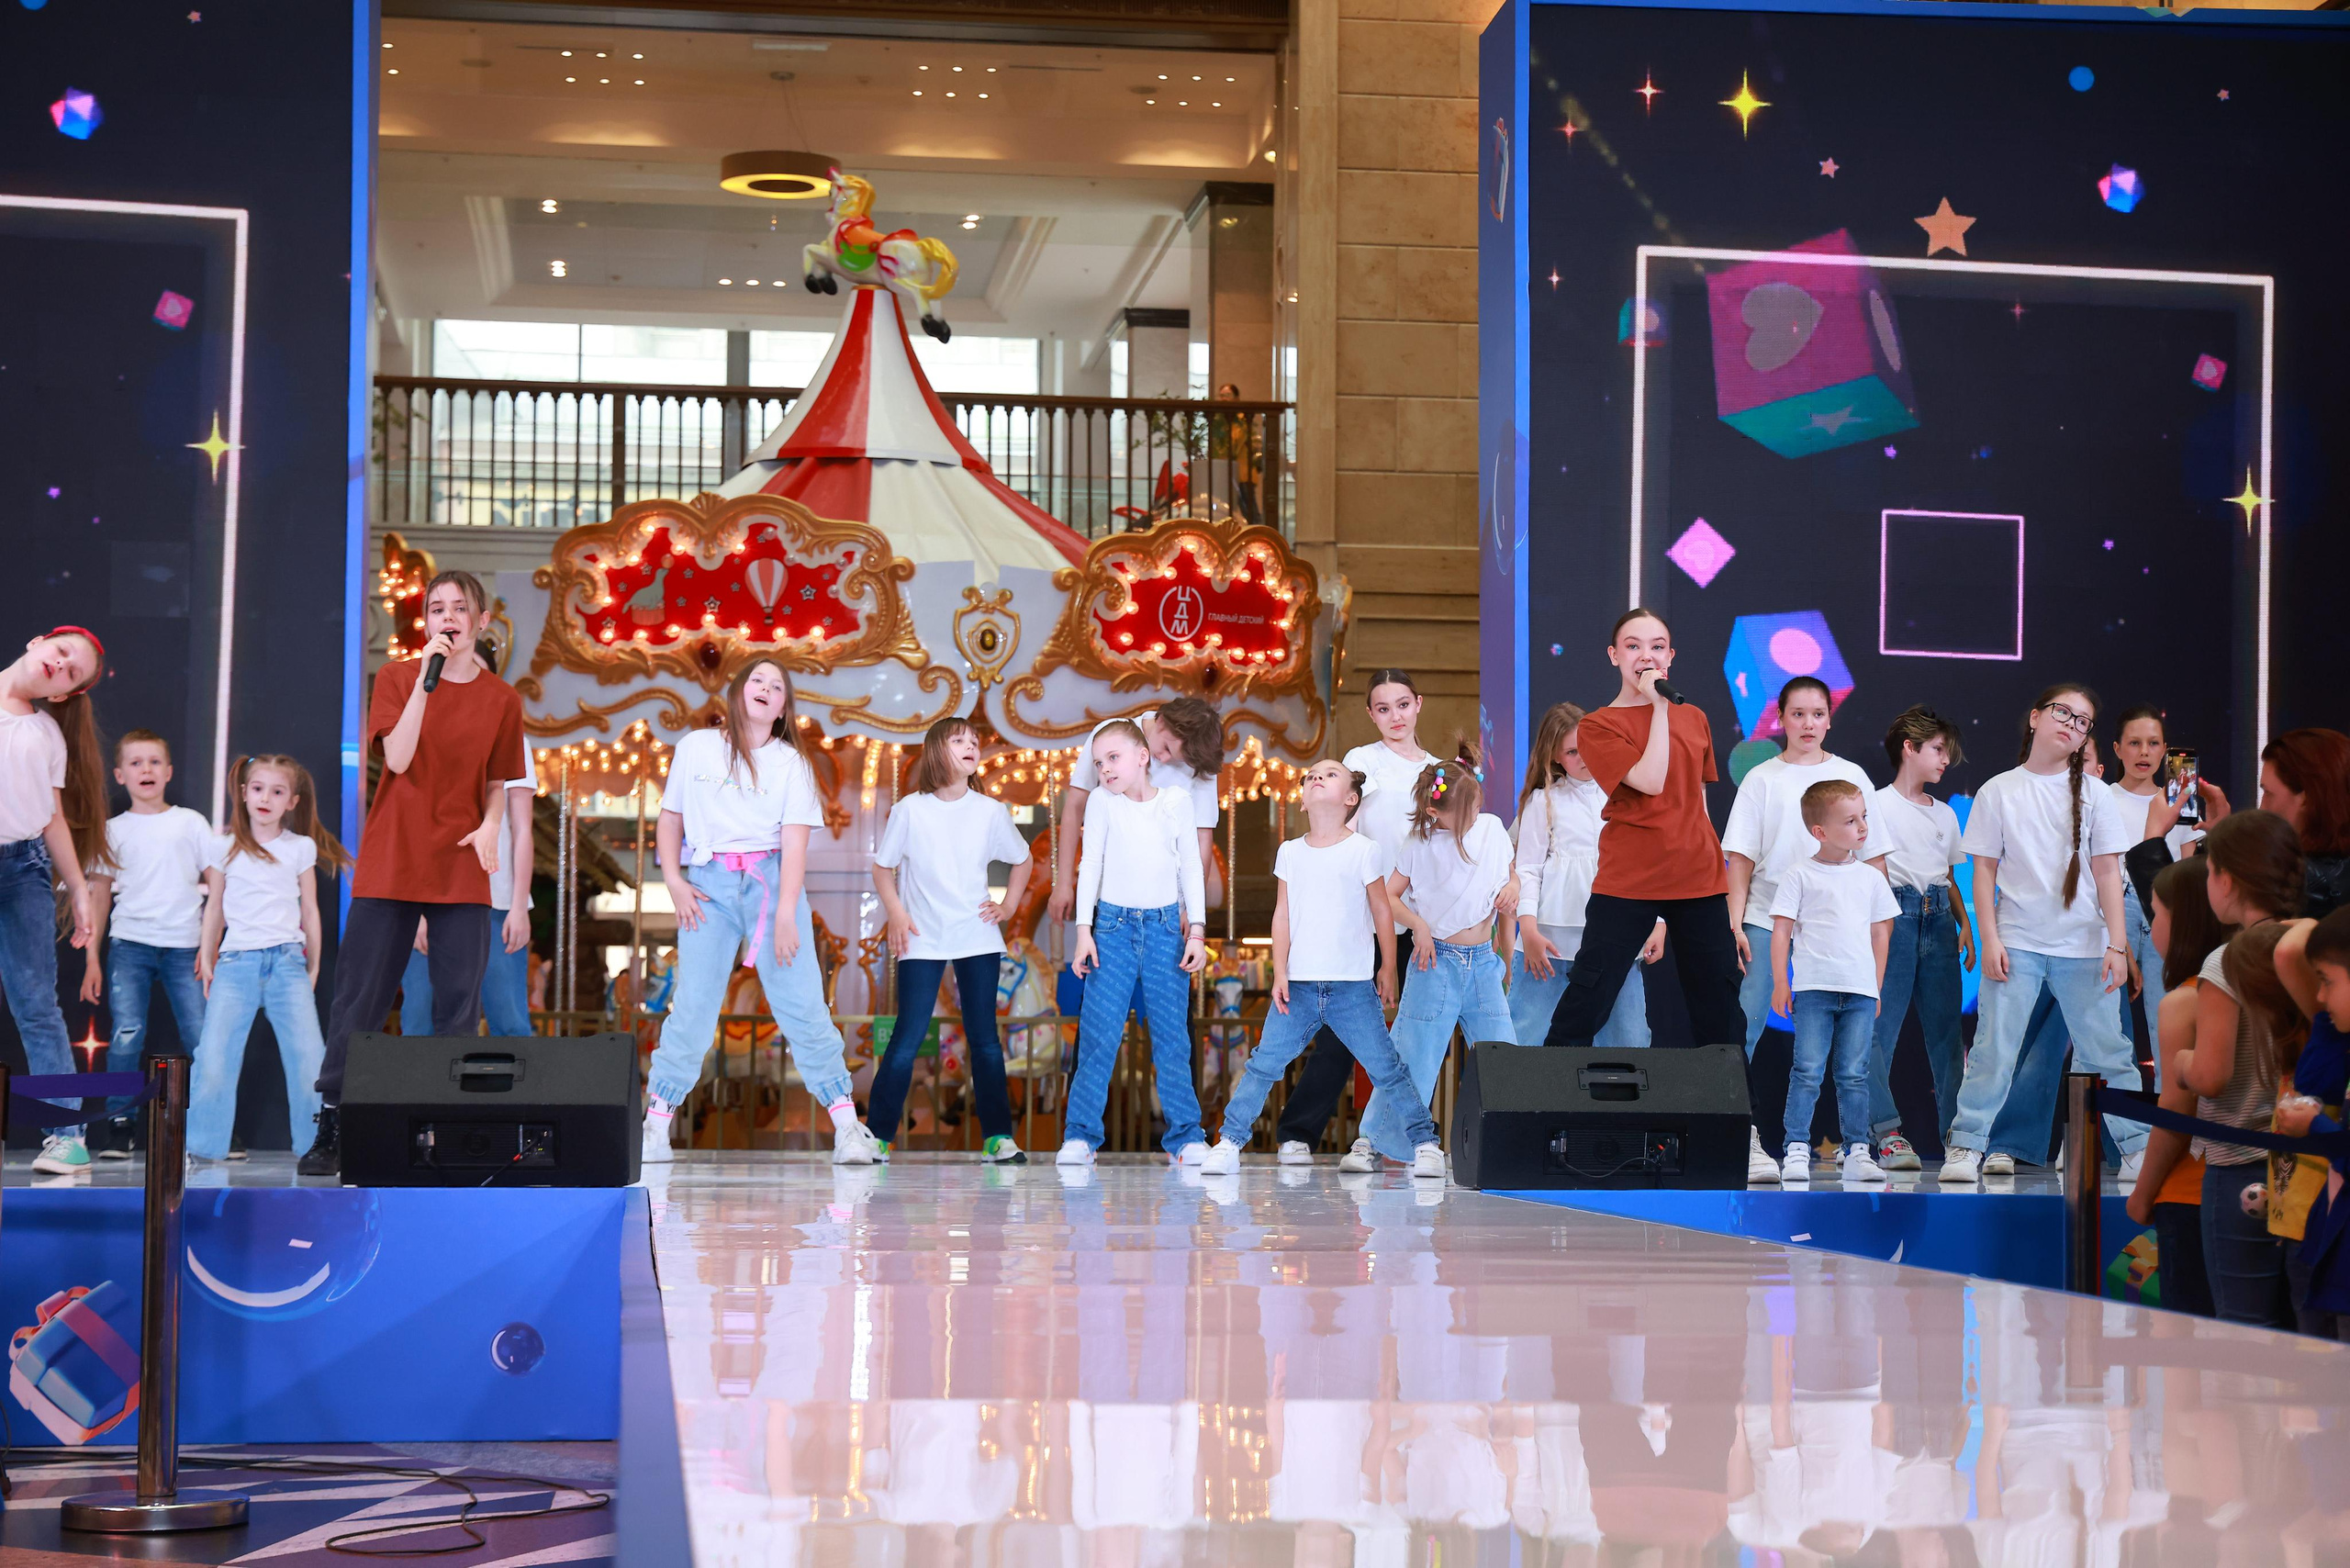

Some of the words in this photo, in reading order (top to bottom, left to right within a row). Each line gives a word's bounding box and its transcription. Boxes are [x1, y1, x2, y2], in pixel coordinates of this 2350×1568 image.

[1170, 585, 1192, 635] ЦДМ
[1208, 612, 1237, 622] ГЛАВНЫЙ
[1238, 614, 1264, 625] ДЕТСКИЙ
